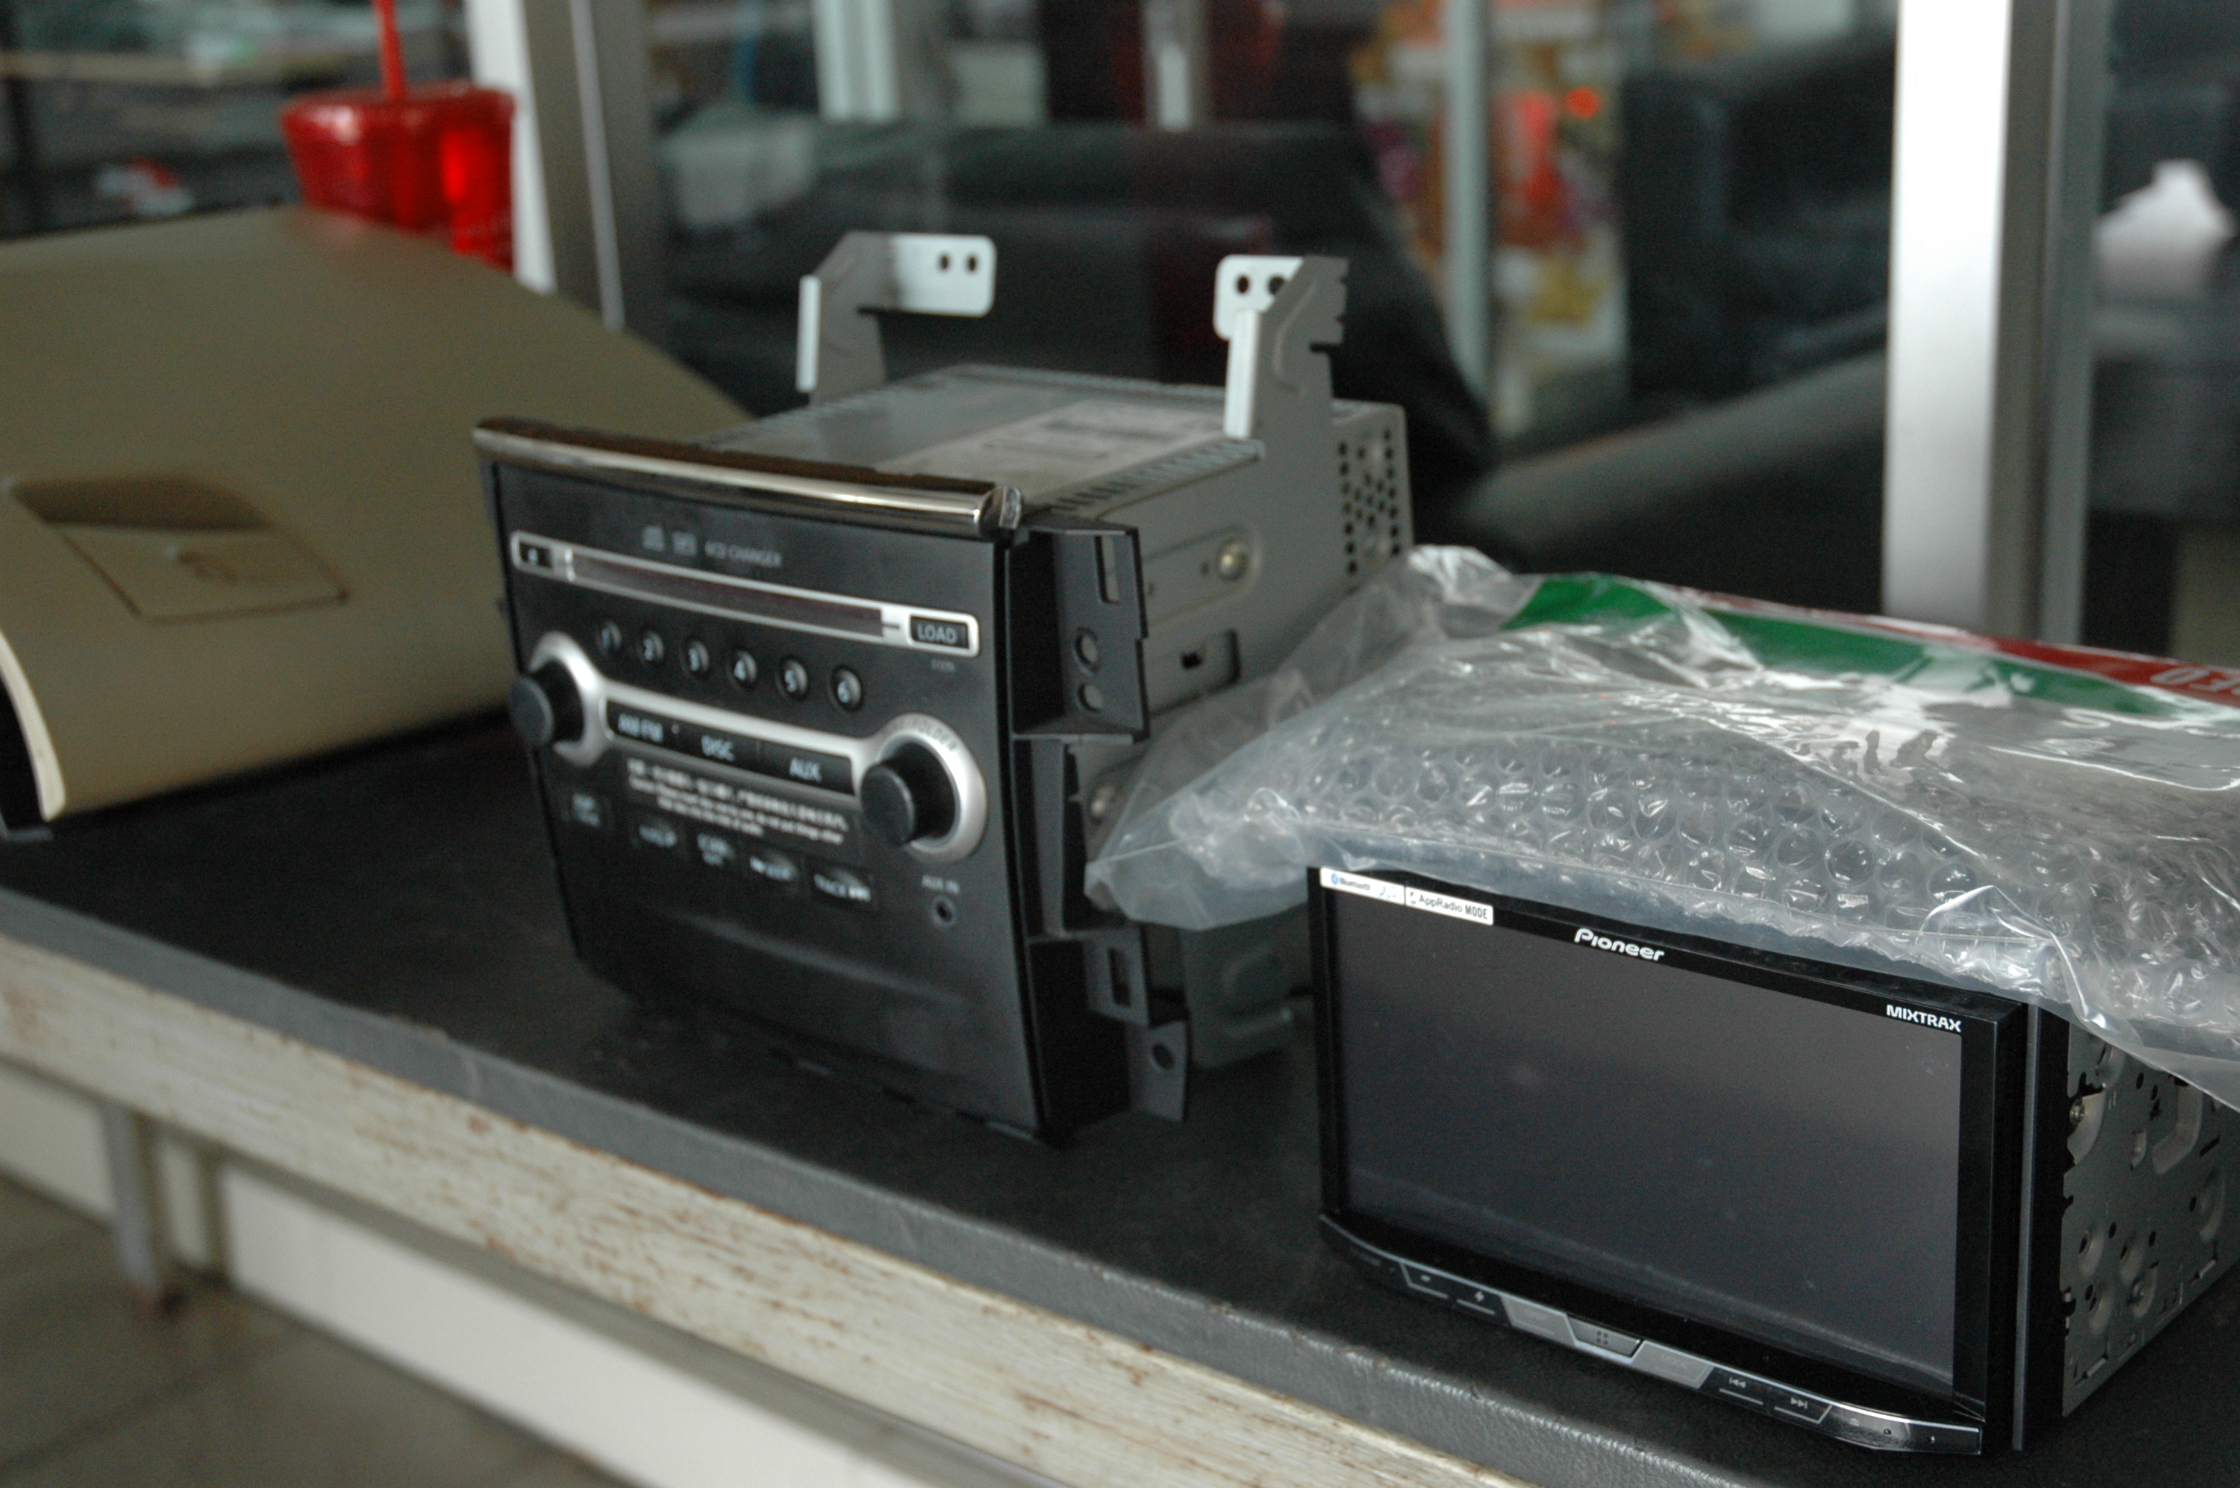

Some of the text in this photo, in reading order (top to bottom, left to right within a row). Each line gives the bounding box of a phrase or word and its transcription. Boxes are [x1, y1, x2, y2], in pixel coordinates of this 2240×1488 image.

[917, 623, 957, 645] LOAD
[734, 658, 747, 681] 4
[784, 669, 797, 693] 5
[837, 681, 851, 703] 6
[789, 757, 823, 782] AUX
[1418, 894, 1463, 914] AppRadio
[1464, 904, 1488, 920] MODE
[1574, 928, 1665, 961] Pioneer
[1886, 1004, 1962, 1033] MIXTRAX
